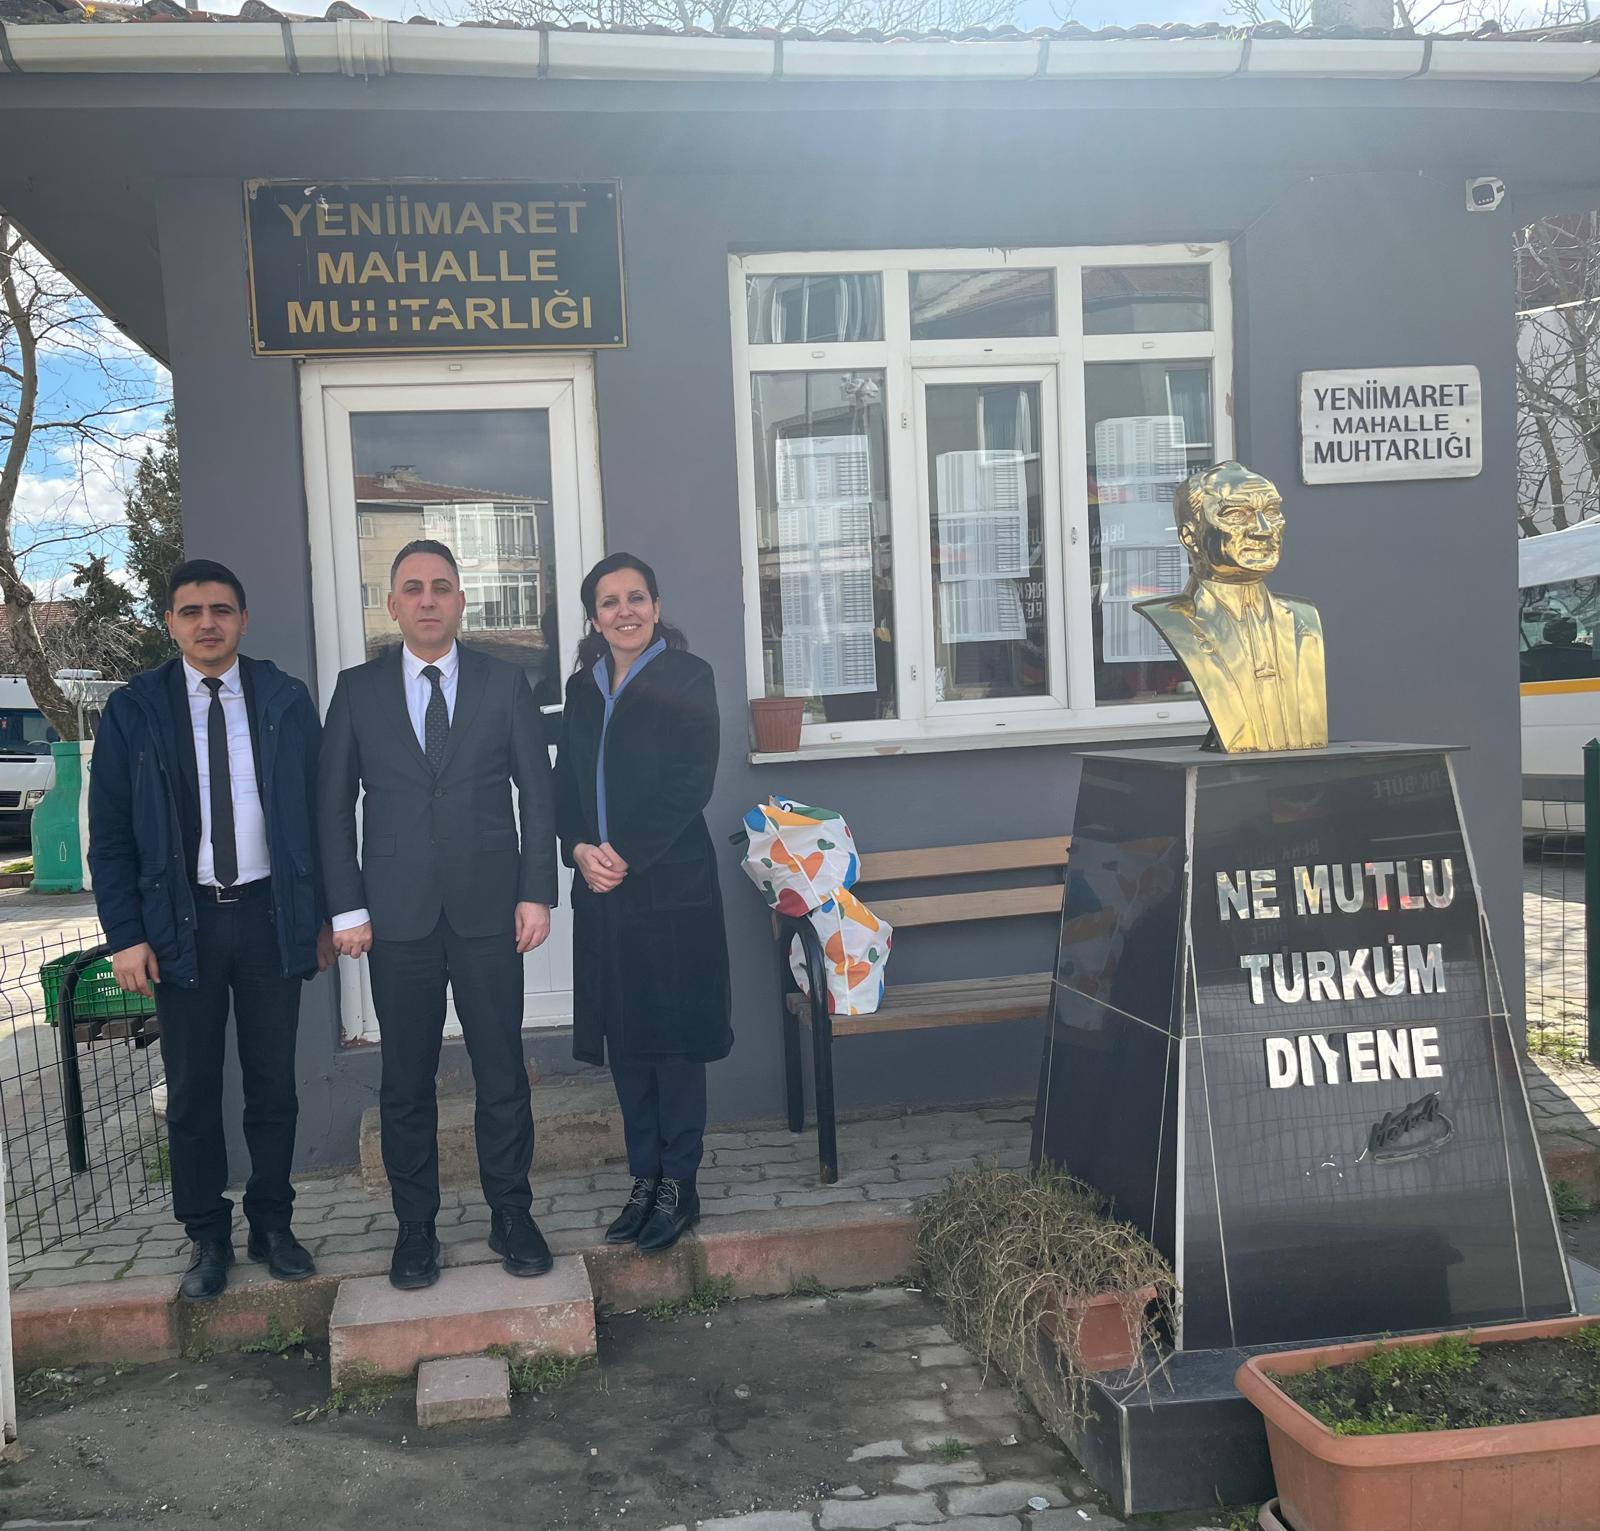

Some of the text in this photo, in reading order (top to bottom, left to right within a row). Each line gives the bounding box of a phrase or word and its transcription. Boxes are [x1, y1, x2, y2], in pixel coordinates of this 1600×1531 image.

[279, 195, 587, 237] YENİİMARET
[317, 249, 559, 285] MAHALLE
[287, 288, 593, 334] MUHTARLIĞI
[1313, 379, 1469, 412] YENİİMARET
[1333, 413, 1449, 435] MAHALLE
[1314, 432, 1471, 464] MUHTARLIĞI
[1216, 858, 1454, 921] NE MUTLU
[1265, 1027, 1443, 1089] DIYENE
